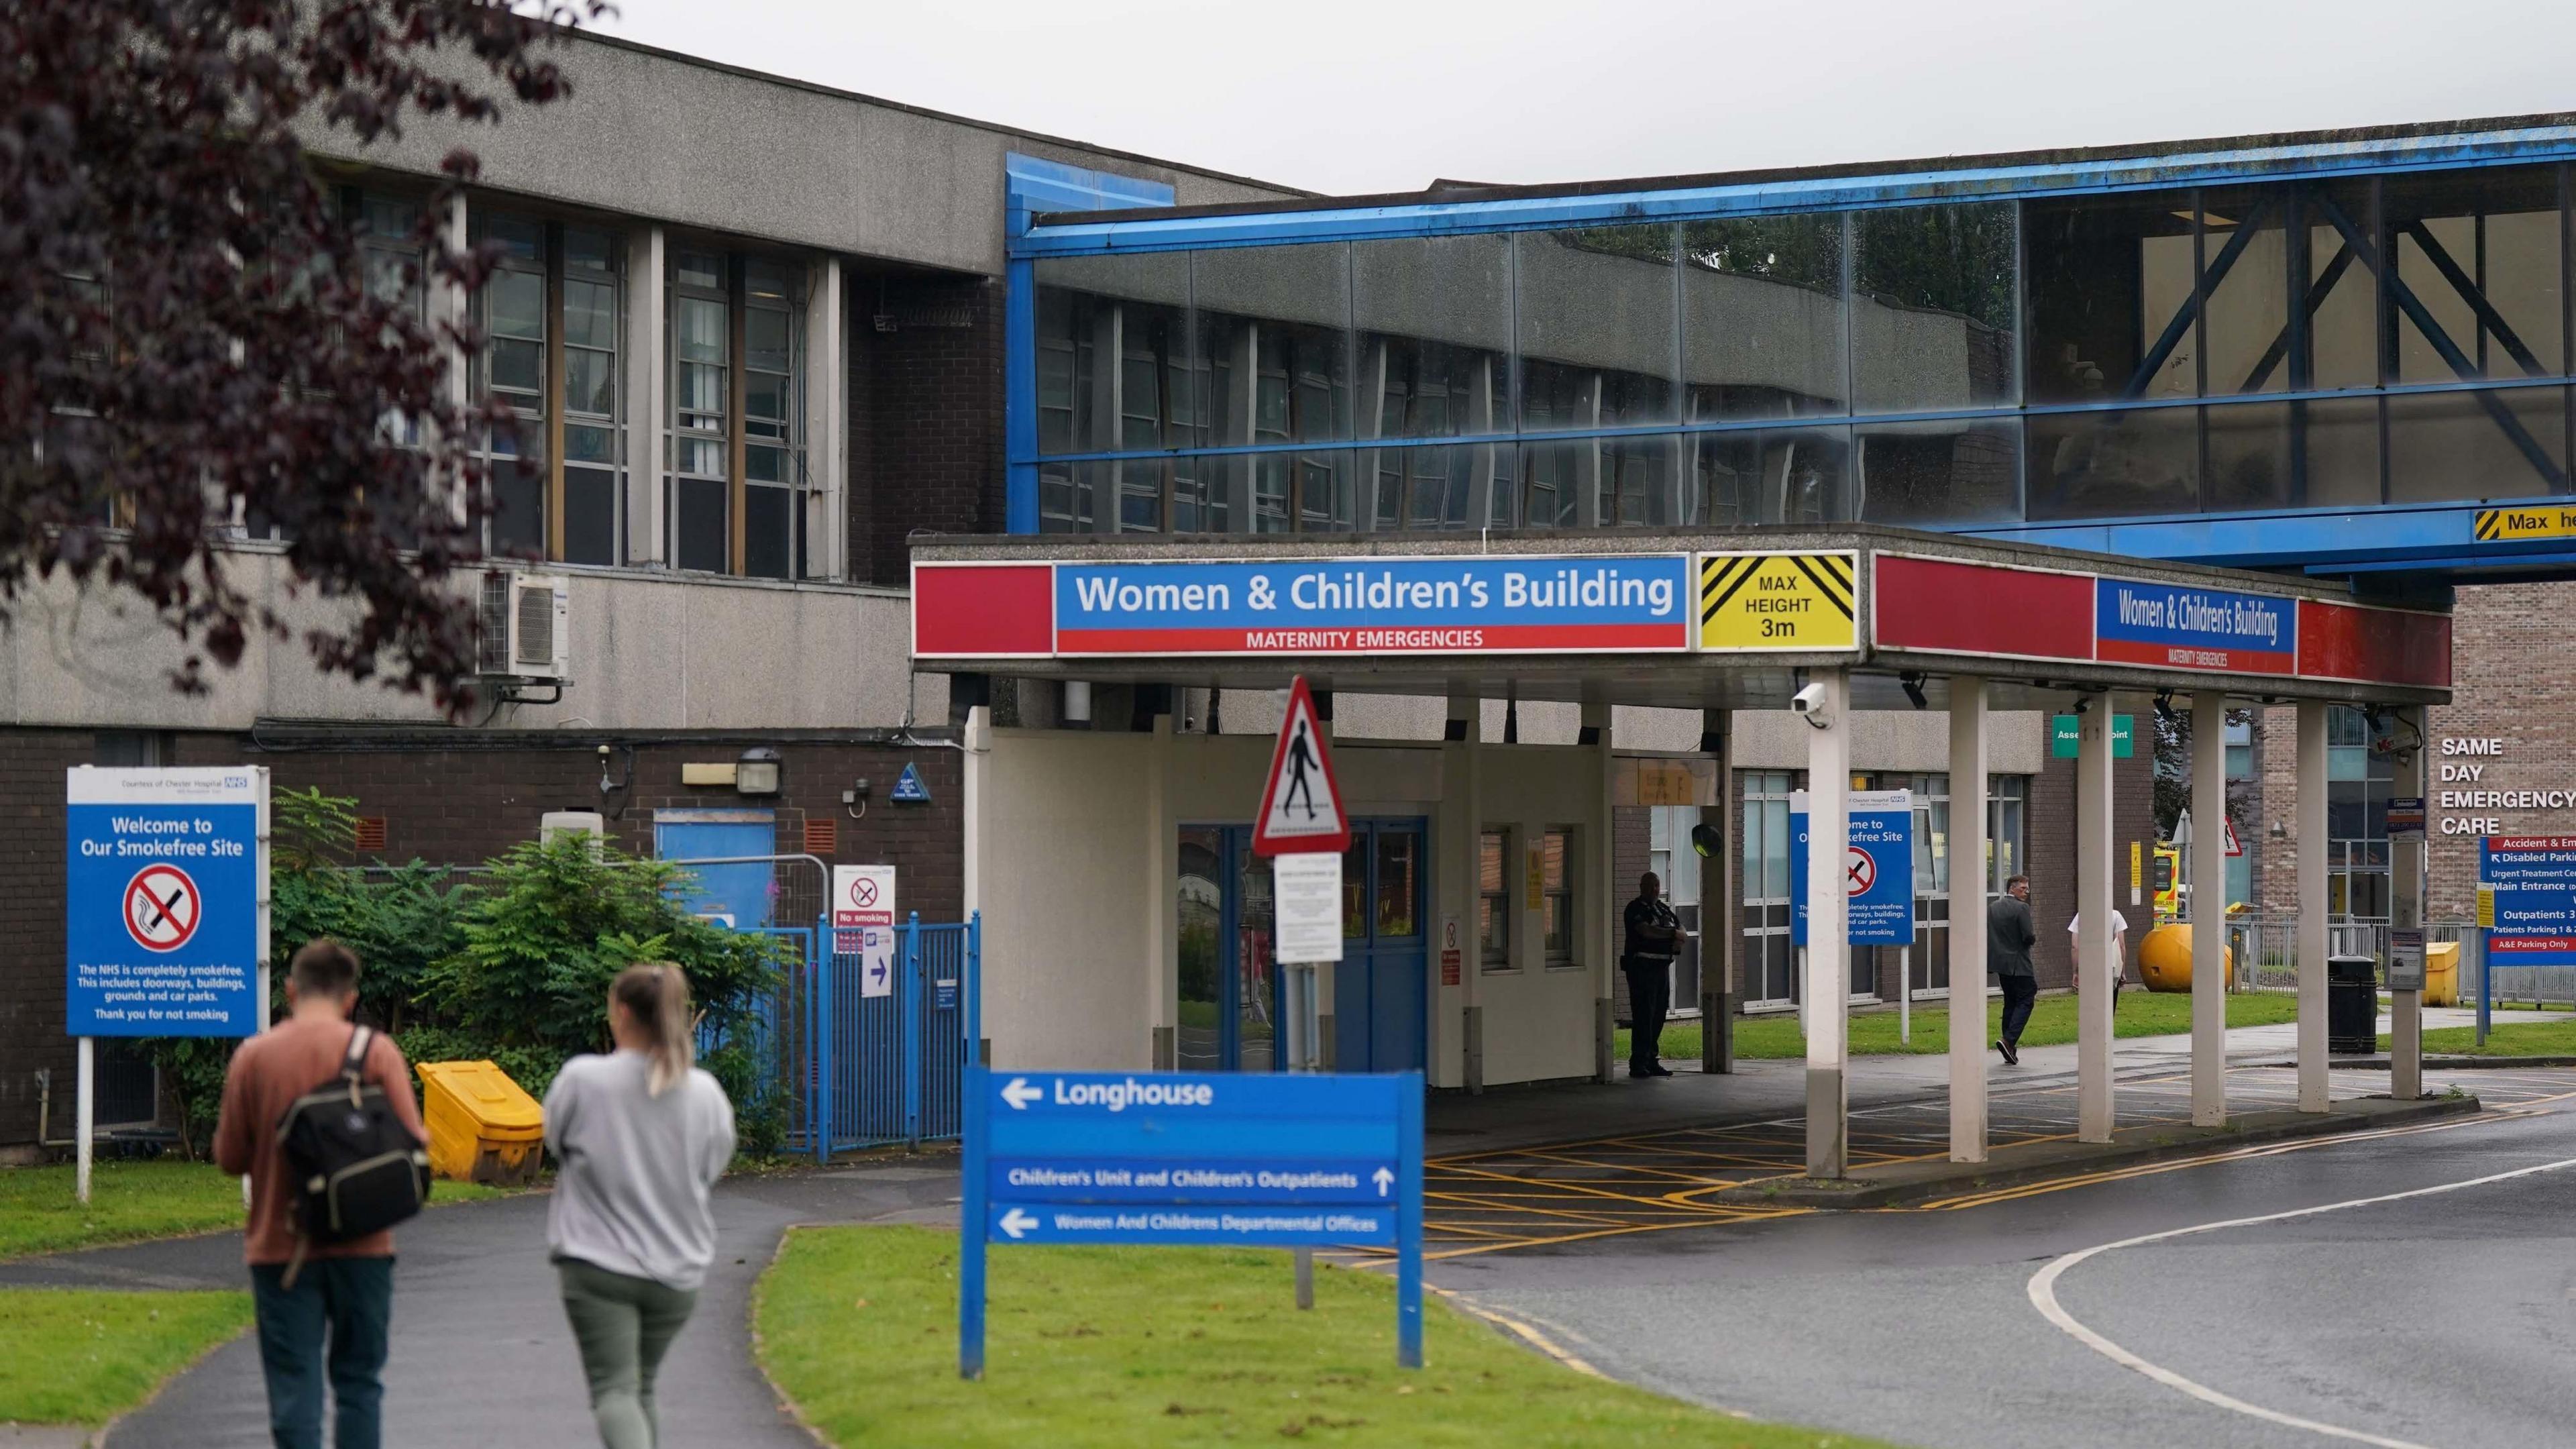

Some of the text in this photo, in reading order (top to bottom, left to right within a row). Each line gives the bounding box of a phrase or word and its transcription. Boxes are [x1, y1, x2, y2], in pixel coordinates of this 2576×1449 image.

[2508, 514, 2548, 531] Max
[1759, 576, 1798, 591] MAX
[1075, 569, 1673, 616] Women & Children's Building
[1746, 598, 1812, 613] HEIGHT
[2118, 588, 2277, 647] Women & Children's Building
[1761, 619, 1795, 638] 3m
[1246, 630, 1483, 649] MATERNITY EMERGENCIES
[2168, 648, 2227, 667] MATERNITY EMERGENCIES
[2441, 738, 2502, 755] SAME
[2441, 765, 2483, 782] DAY
[121, 777, 248, 789] Countess of Chester Hospital NHS
[2440, 791, 2576, 808] EMERGENCY
[111, 816, 213, 834] Welcome to
[1871, 820, 1883, 829] to
[2440, 817, 2500, 835] CARE
[1882, 831, 1903, 842] Site
[2503, 838, 2547, 847] Accident
[2550, 839, 2559, 847] &
[80, 838, 244, 857] Our Smokefree Site
[2502, 852, 2546, 863] Disabled
[2491, 869, 2520, 879] Urgent
[2521, 869, 2563, 877] Treatment
[2493, 881, 2518, 891] Main
[2522, 881, 2566, 891] Entrance
[840, 913, 889, 924] No smoking
[1874, 911, 1906, 919] buildings,
[2504, 910, 2576, 922] Outpatients 3
[1868, 928, 1895, 936] smoking
[2527, 925, 2557, 934] Parking
[2498, 940, 2569, 949] A&E Parking Only
[78, 964, 245, 977] The NHS is completely smokefree.
[77, 977, 246, 991] This includes doorways, buildings,
[104, 990, 219, 1004] grounds and car parks.
[95, 1008, 229, 1022] Thank you for not smoking
[1055, 1078, 1213, 1112] Longhouse
[1008, 1167, 1358, 1191] Children's Unit and Children's Outpatients
[1054, 1213, 1379, 1234] Women And Childrens Departmental Offices
